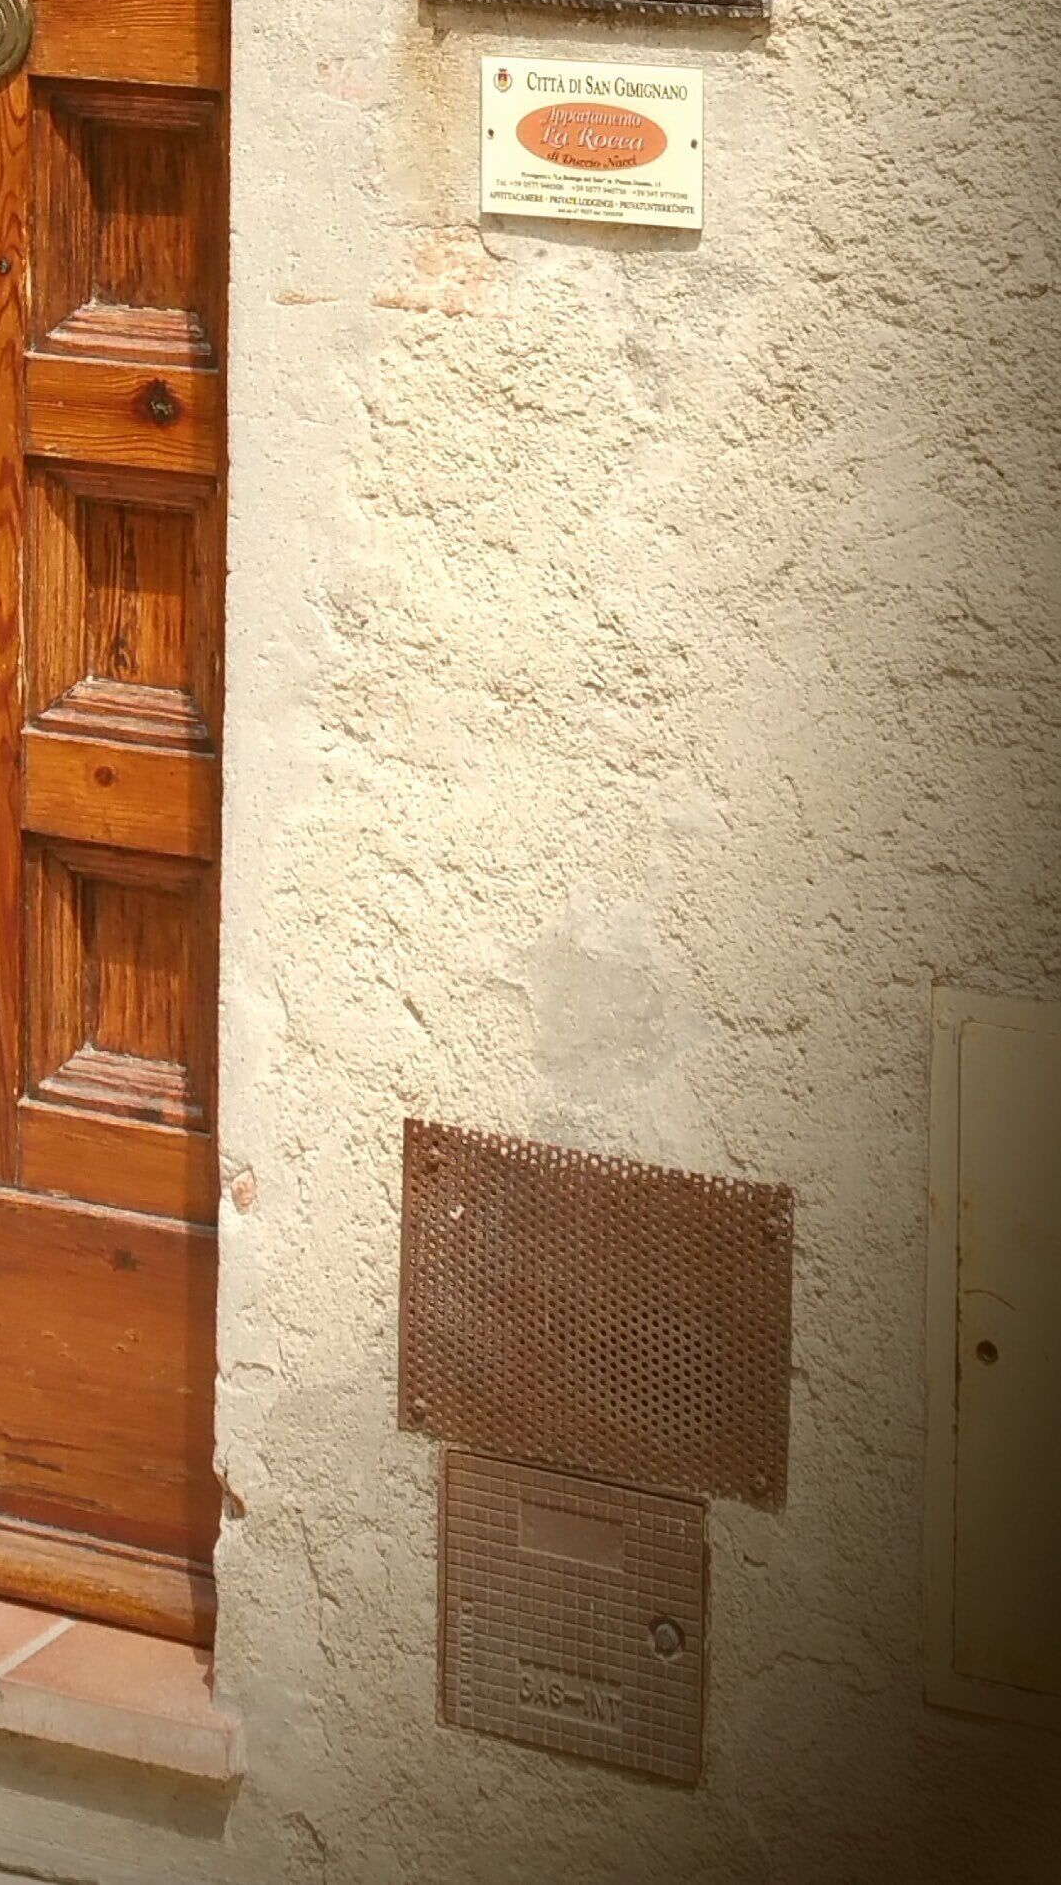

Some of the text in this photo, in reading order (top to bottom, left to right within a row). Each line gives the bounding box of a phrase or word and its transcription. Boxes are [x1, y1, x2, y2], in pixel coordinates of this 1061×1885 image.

[526, 71, 688, 101] CITTÀ DI SAN GIMIGNANO
[542, 107, 642, 127] Appartamento
[541, 126, 645, 151] La Rocca
[547, 150, 558, 161] di
